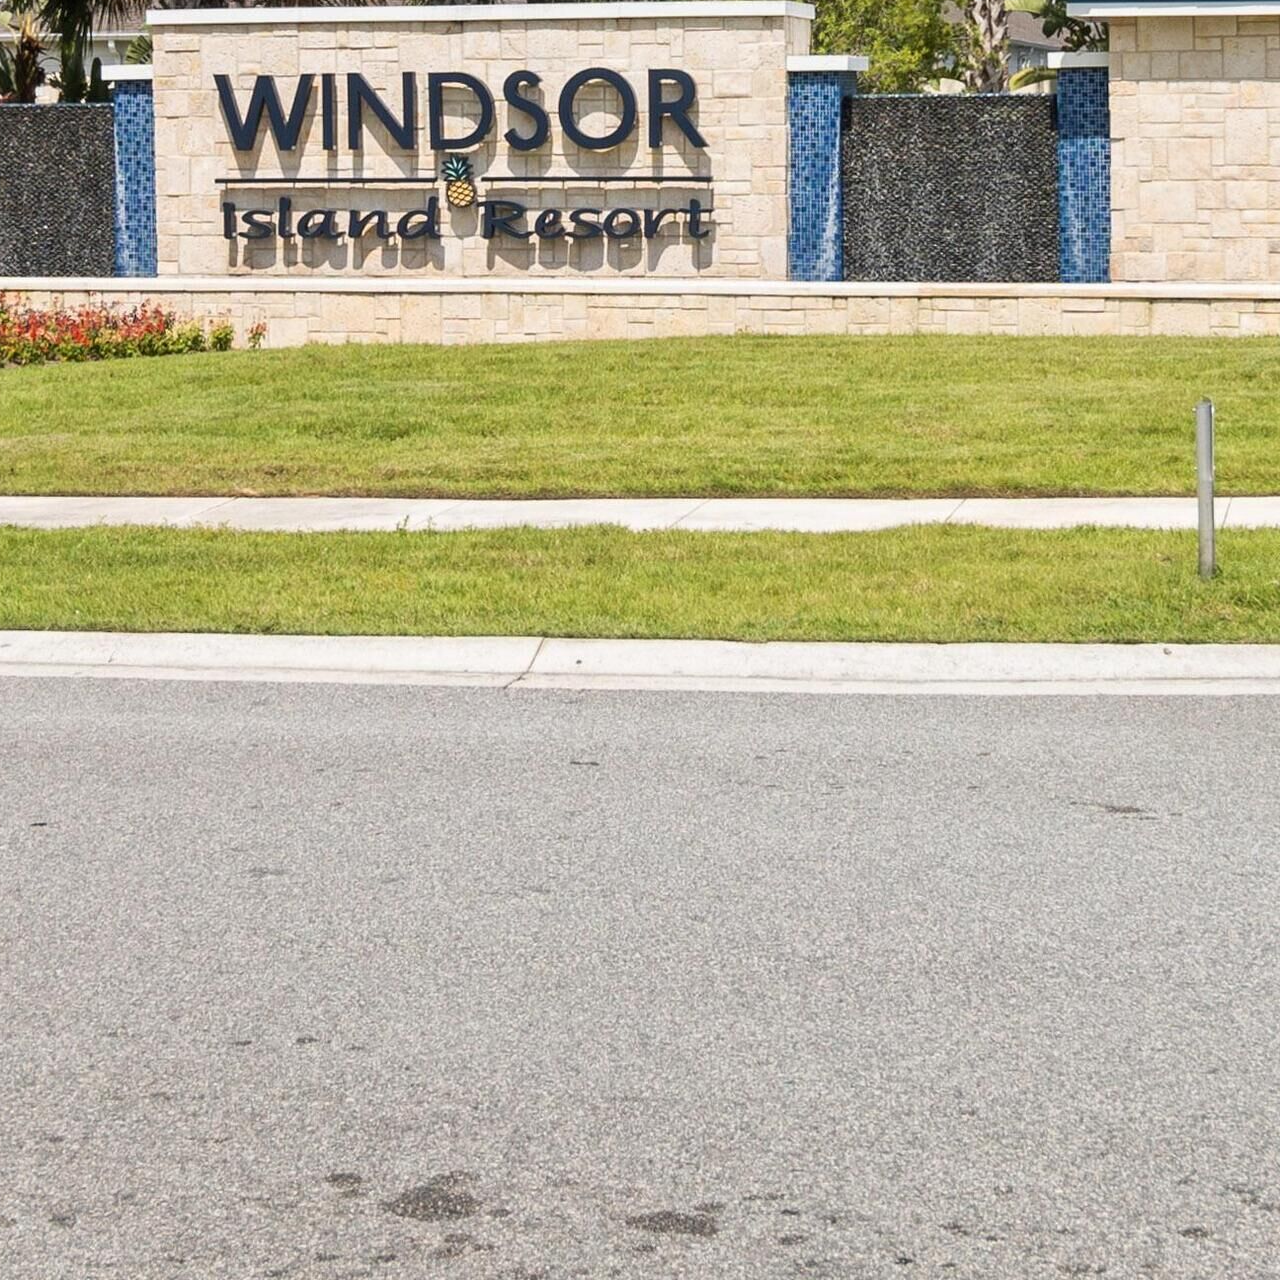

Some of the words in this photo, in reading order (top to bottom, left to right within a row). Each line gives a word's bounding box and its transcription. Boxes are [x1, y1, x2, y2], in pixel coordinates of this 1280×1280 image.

[213, 67, 709, 151] WINDSOR
[222, 195, 443, 240] Island
[477, 196, 714, 241] Resort
